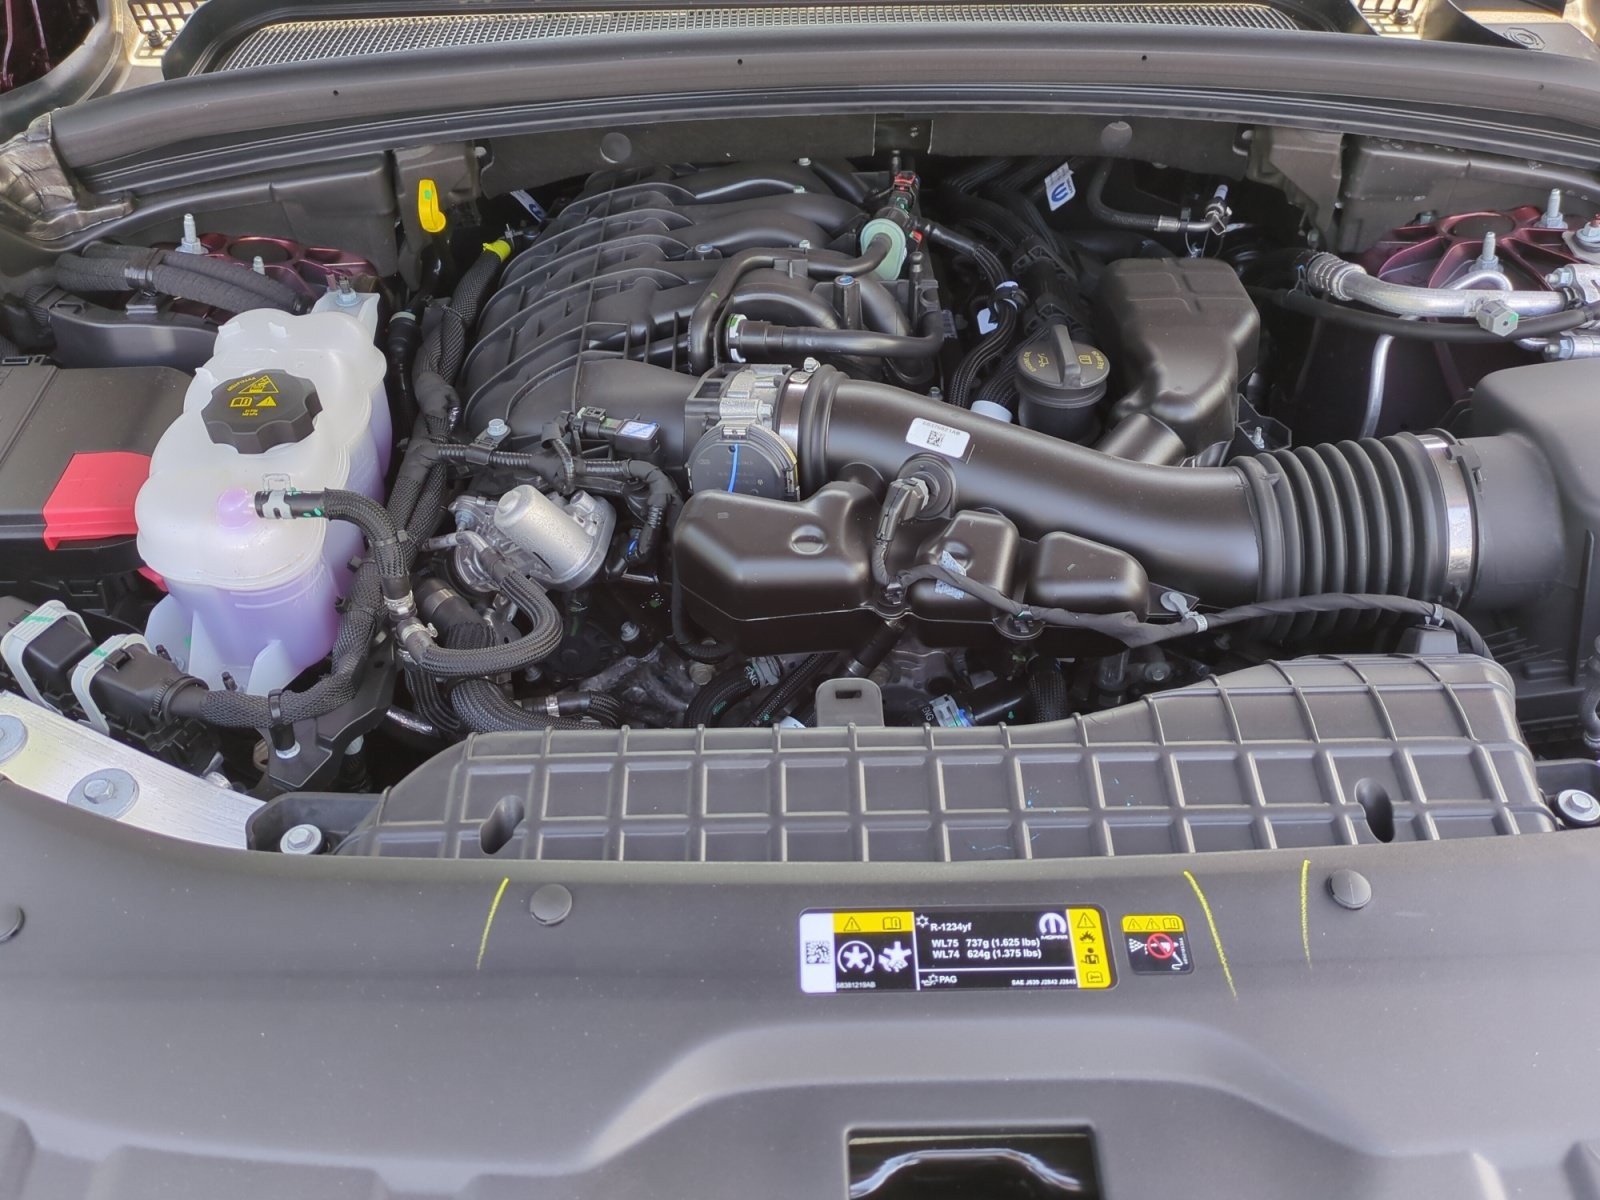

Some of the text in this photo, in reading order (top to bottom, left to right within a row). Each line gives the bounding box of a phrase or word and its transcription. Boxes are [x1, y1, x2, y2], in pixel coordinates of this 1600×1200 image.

[921, 706, 935, 721] ENG
[930, 922, 972, 933] R-1234yf
[931, 937, 1041, 949] WL75 737g (1.625 lbs)
[932, 948, 1042, 960] WL74 624g (1.375 lbs)
[939, 975, 958, 984] PAG
